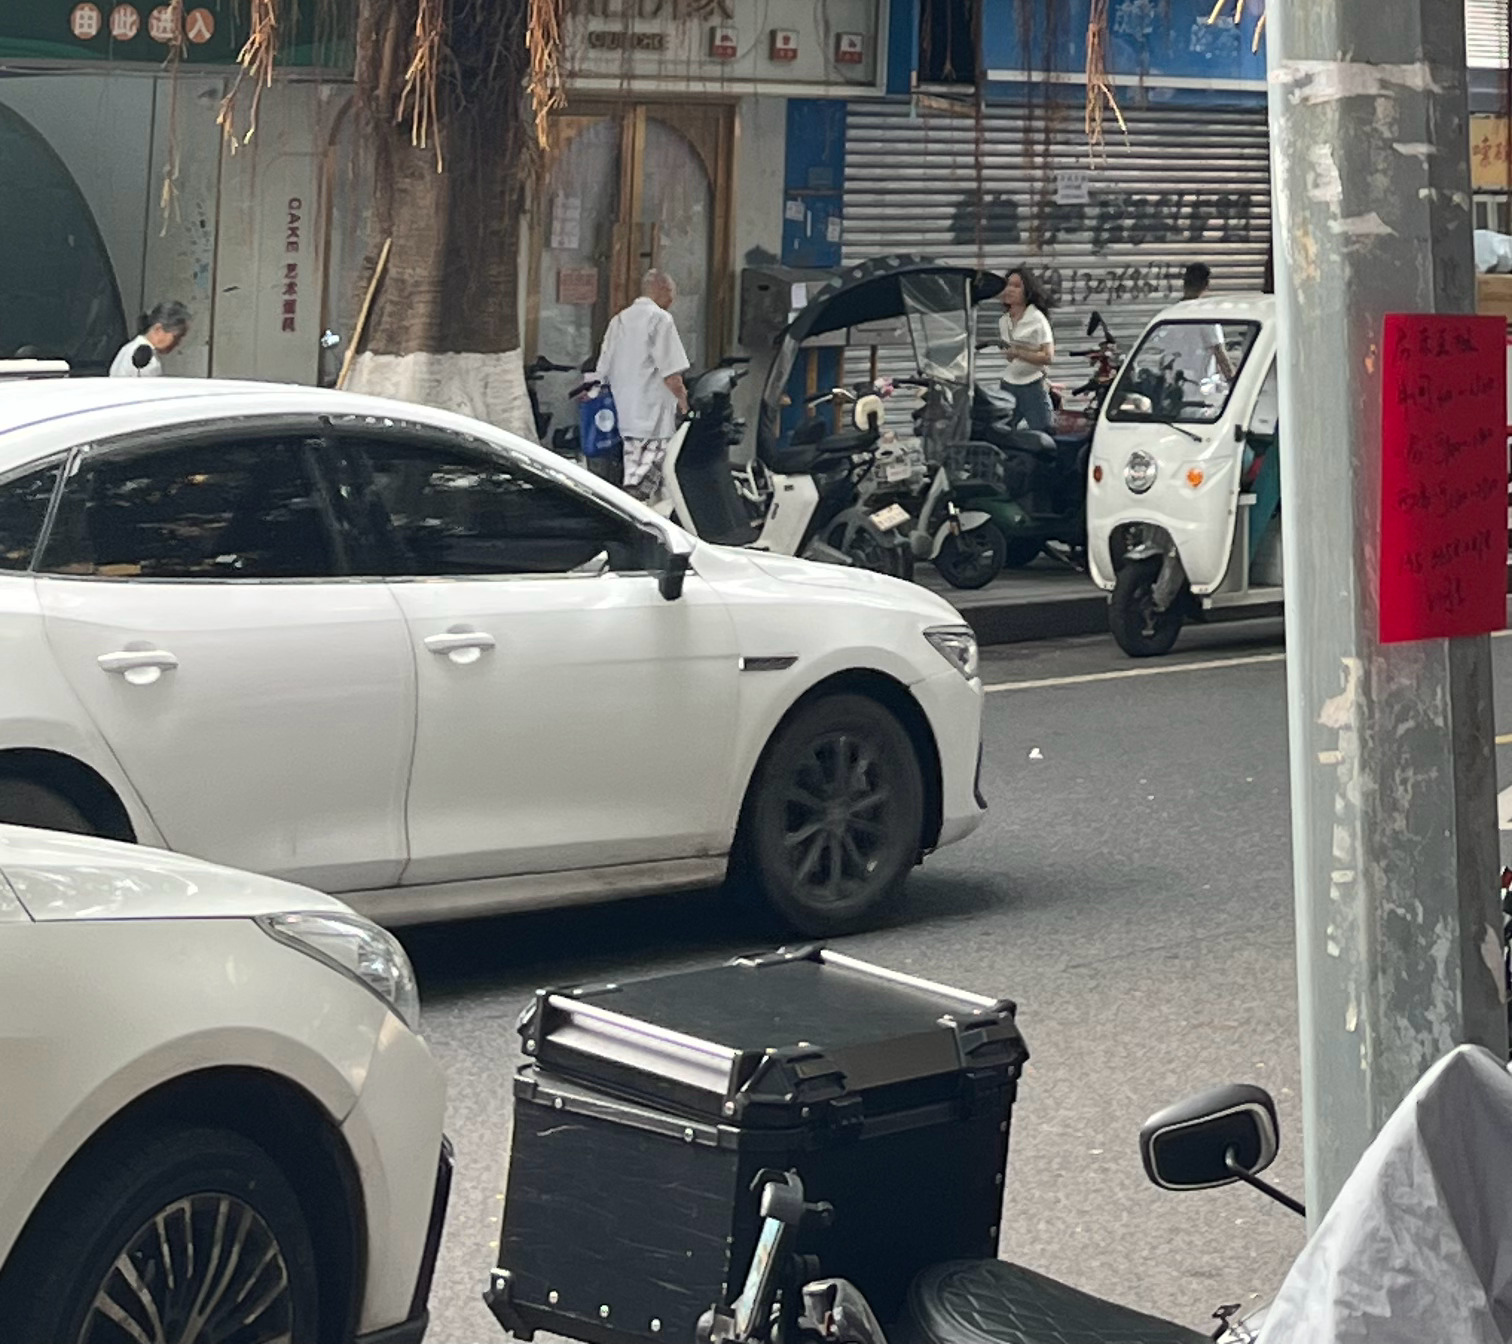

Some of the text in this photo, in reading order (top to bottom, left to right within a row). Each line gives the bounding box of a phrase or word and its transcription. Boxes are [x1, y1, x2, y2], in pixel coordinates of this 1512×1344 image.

[75, 9, 212, 41] 由此进入
[288, 197, 302, 253] CAKE
